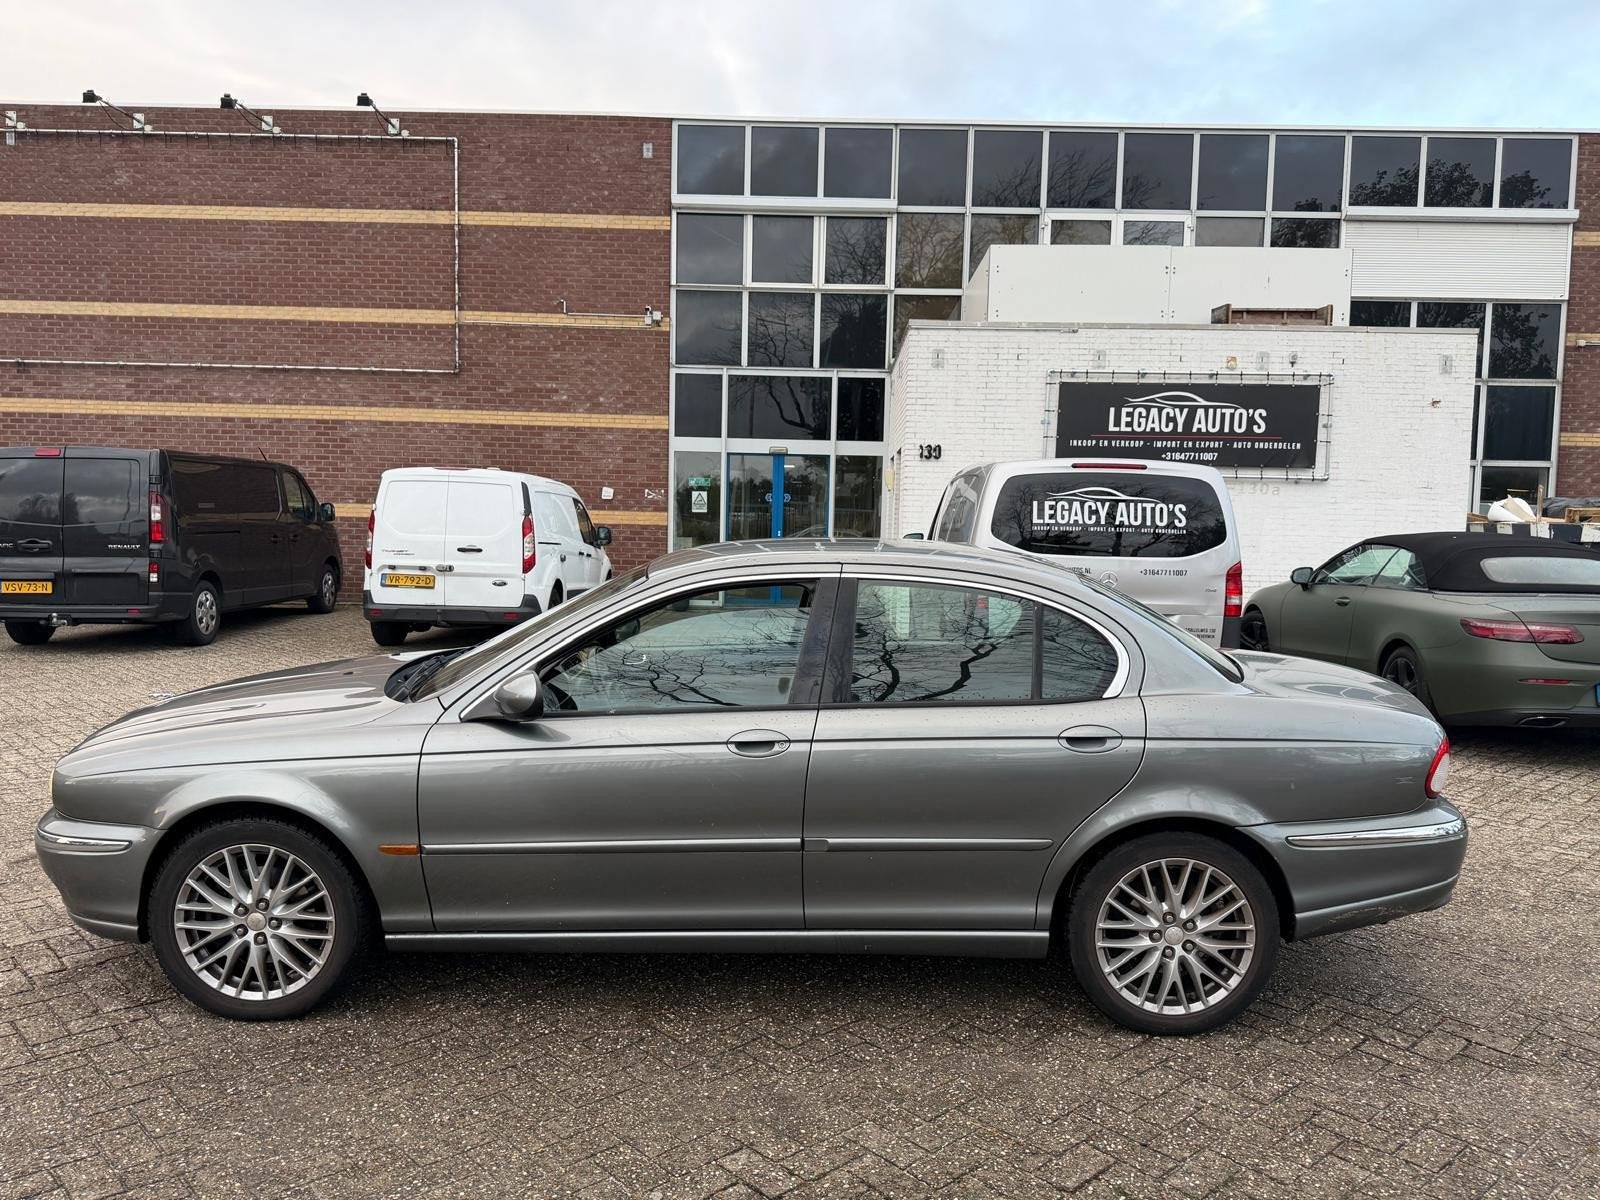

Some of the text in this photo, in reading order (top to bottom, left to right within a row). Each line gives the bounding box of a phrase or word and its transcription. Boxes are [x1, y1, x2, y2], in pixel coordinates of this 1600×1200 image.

[1108, 407, 1267, 434] LEGACY AUTO'S
[1069, 439, 1096, 447] INKOOP
[1111, 440, 1144, 448] VERKOOP
[1153, 440, 1180, 448] IMPORT
[1233, 441, 1252, 449] AUTO
[1254, 442, 1301, 450] ONDERDELEN
[919, 444, 942, 460] 130
[1161, 452, 1218, 461] +31647711007
[1032, 500, 1187, 527] LEGACY AUTO'S
[1139, 568, 1188, 577] +31647711007
[388, 574, 432, 585] VR-792-D
[4, 582, 48, 592] VSV-73-N
